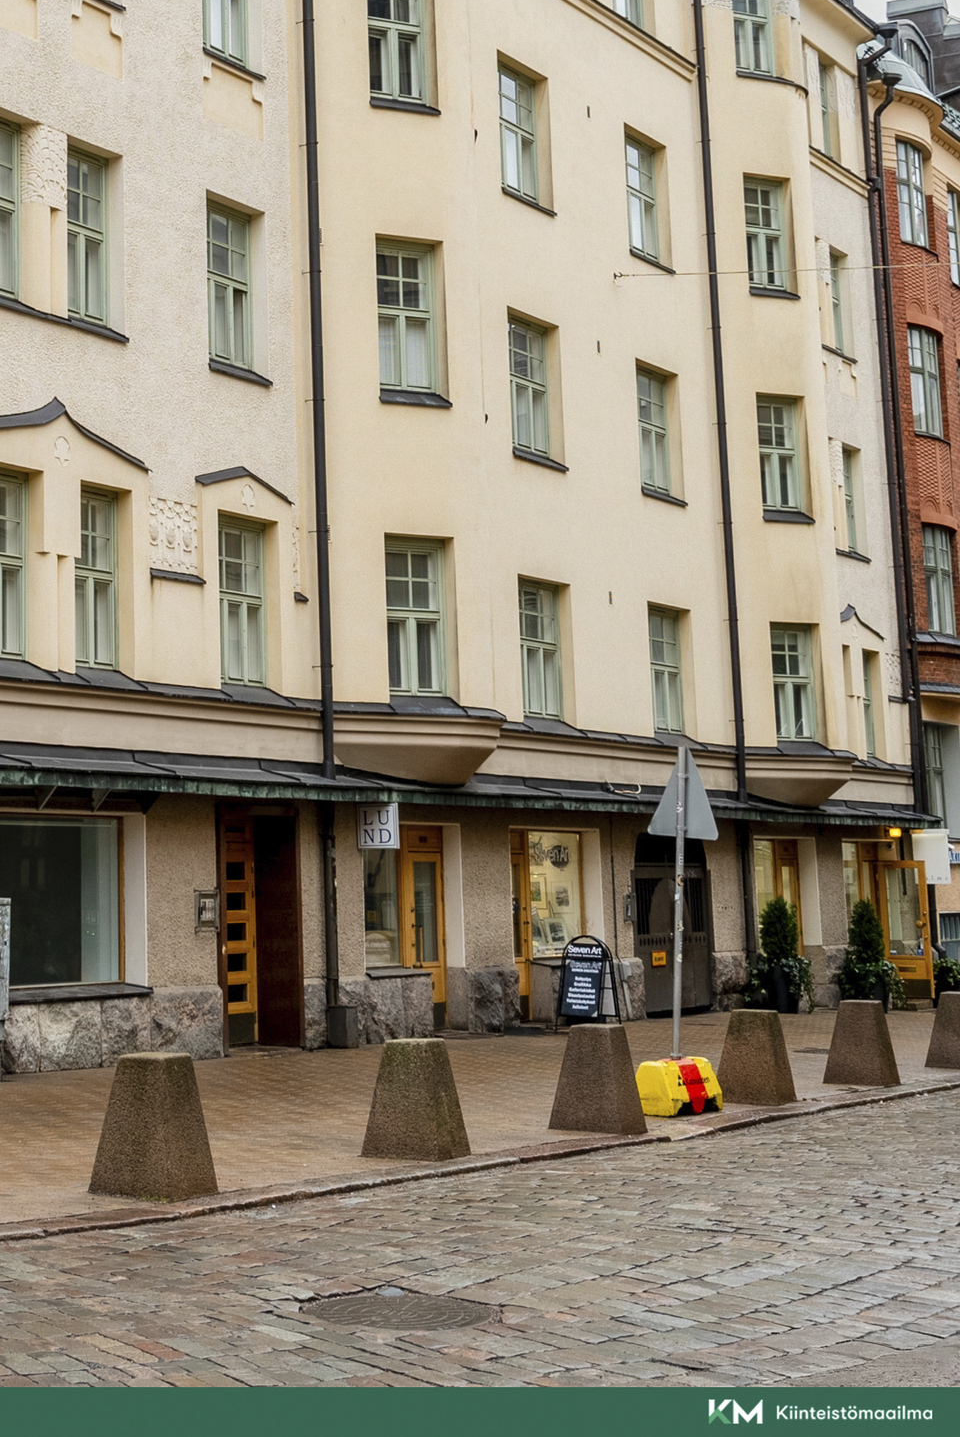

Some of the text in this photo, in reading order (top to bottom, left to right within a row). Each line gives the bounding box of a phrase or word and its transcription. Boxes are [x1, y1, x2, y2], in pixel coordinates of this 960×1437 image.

[362, 809, 390, 826] LU
[362, 828, 392, 844] ND
[568, 944, 602, 955] Seven Art
